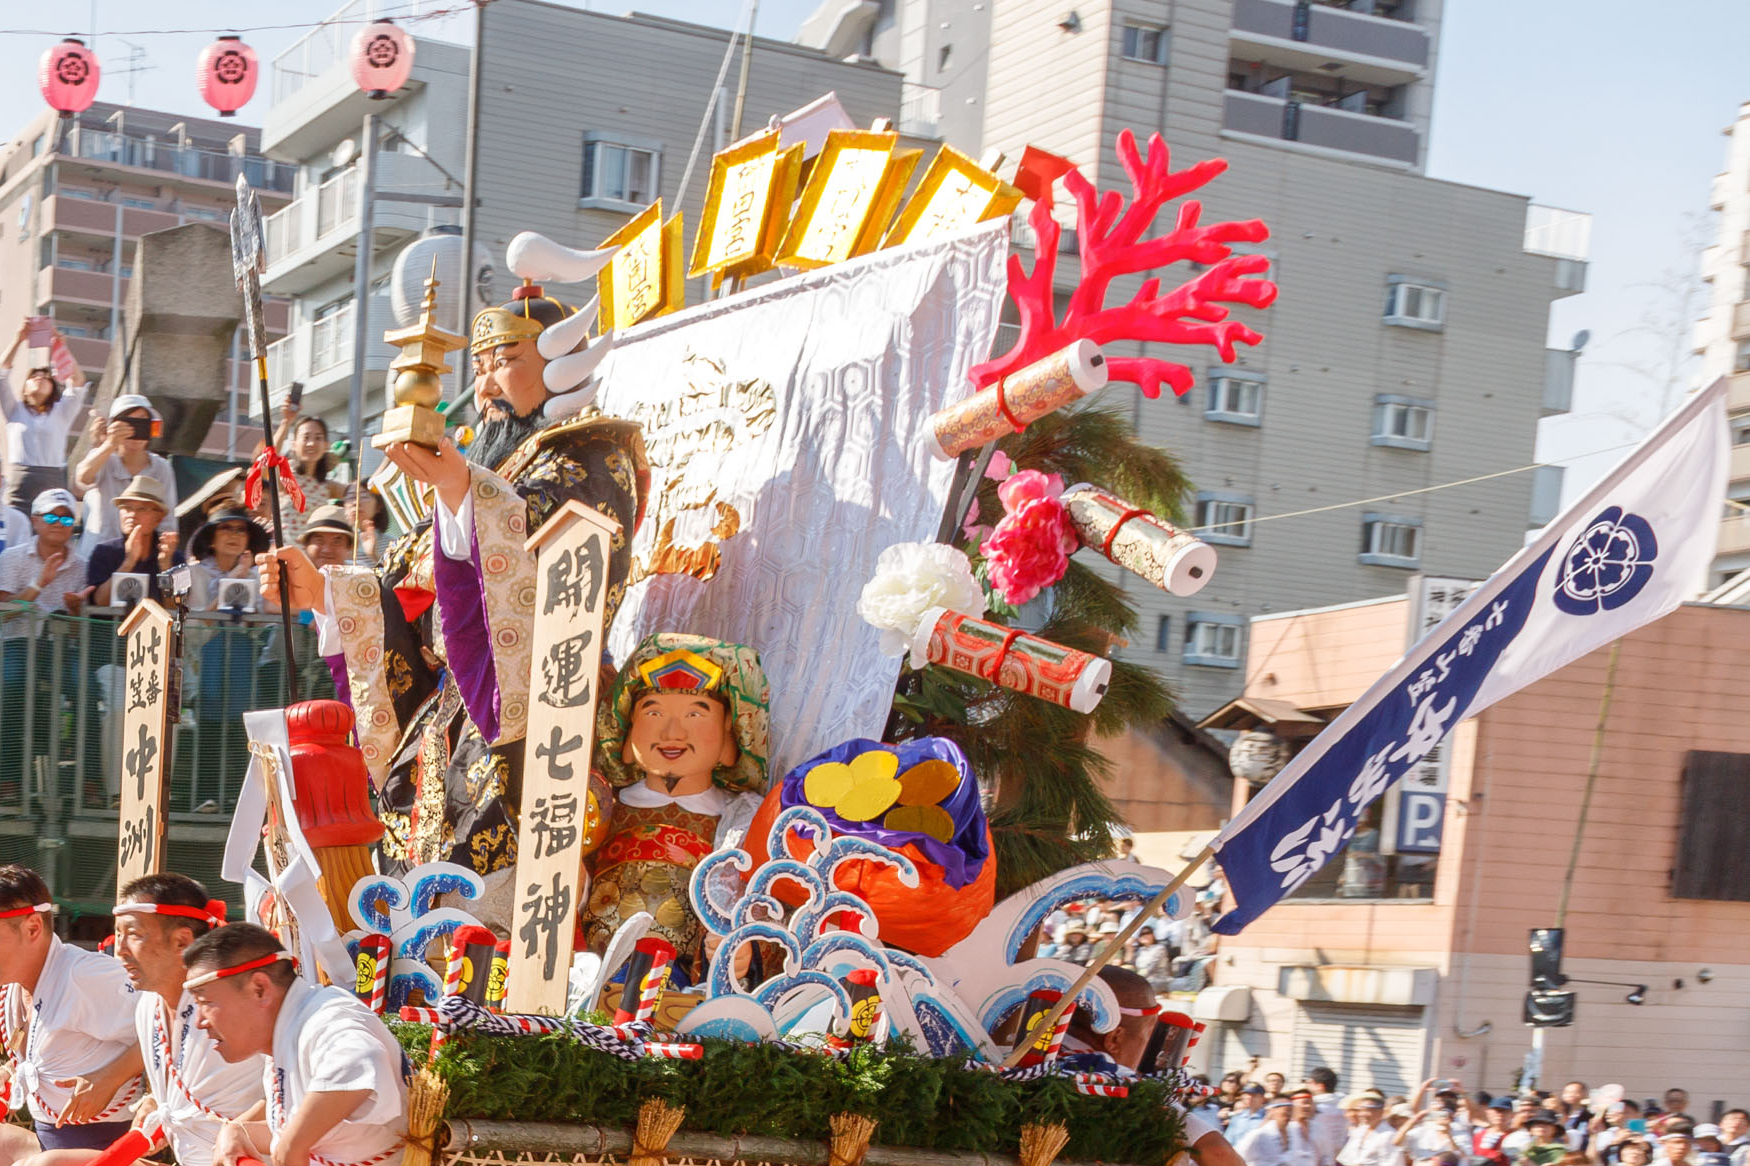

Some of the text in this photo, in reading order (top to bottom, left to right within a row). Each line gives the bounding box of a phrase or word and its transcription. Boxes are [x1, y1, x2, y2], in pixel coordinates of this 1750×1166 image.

[120, 723, 158, 875] 中洲
[519, 533, 604, 980] 開運七福神
[1402, 794, 1442, 846] P
